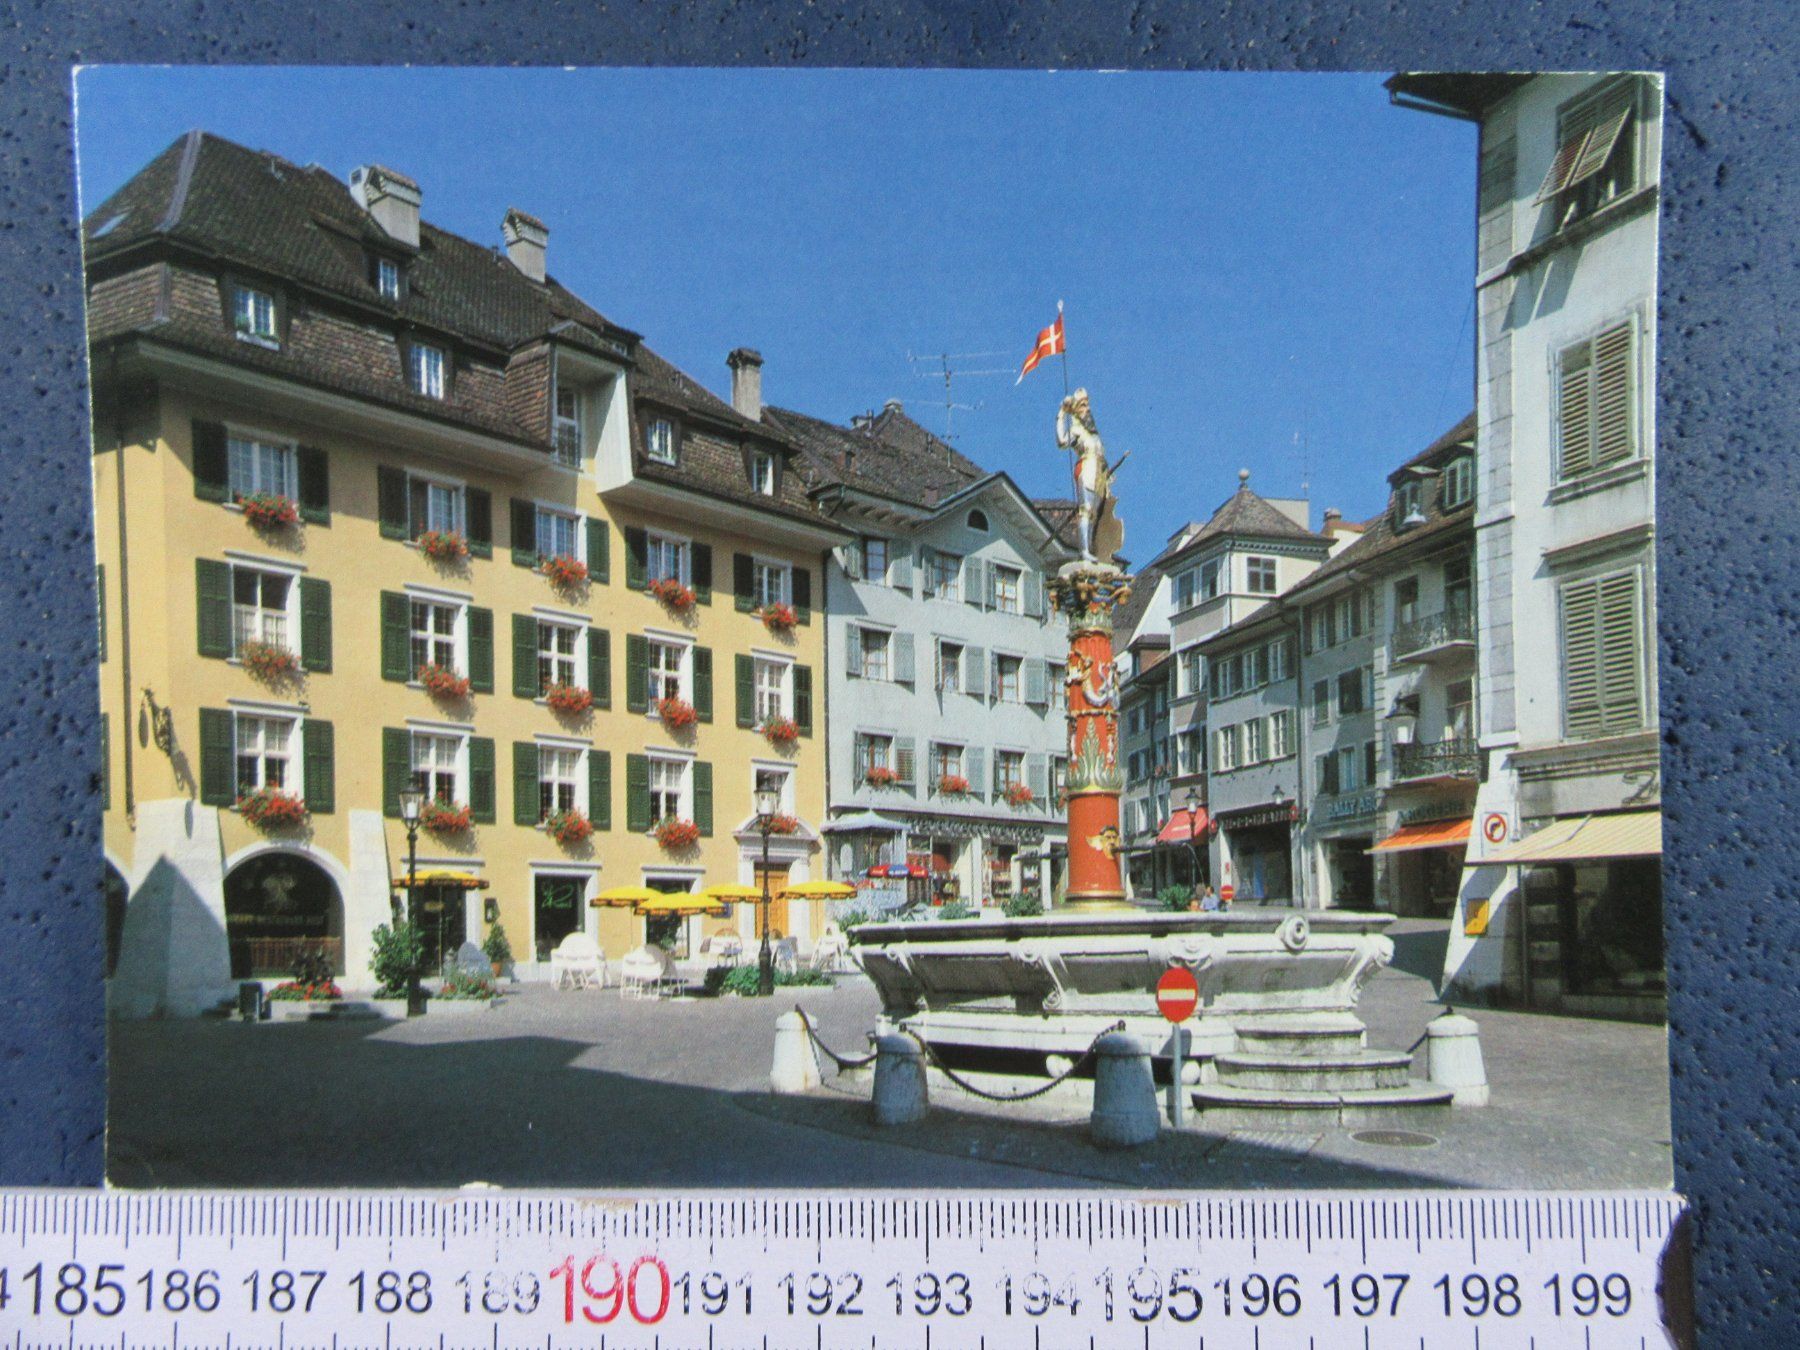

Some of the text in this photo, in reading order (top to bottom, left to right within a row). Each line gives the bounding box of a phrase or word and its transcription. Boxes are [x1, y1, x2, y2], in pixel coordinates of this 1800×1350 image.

[23, 1255, 126, 1322] 185
[137, 1269, 220, 1313] 186
[243, 1270, 327, 1313] 187
[349, 1270, 432, 1314] 188
[456, 1271, 540, 1315] 189
[550, 1255, 670, 1325] 190
[674, 1271, 751, 1316] 191
[778, 1272, 863, 1316] 192
[886, 1272, 972, 1316] 193
[996, 1272, 1082, 1316] 194
[1095, 1267, 1203, 1323] 195
[1214, 1273, 1301, 1317] 196
[1323, 1273, 1410, 1317] 197
[1433, 1273, 1522, 1317] 198
[1544, 1273, 1631, 1317] 199
